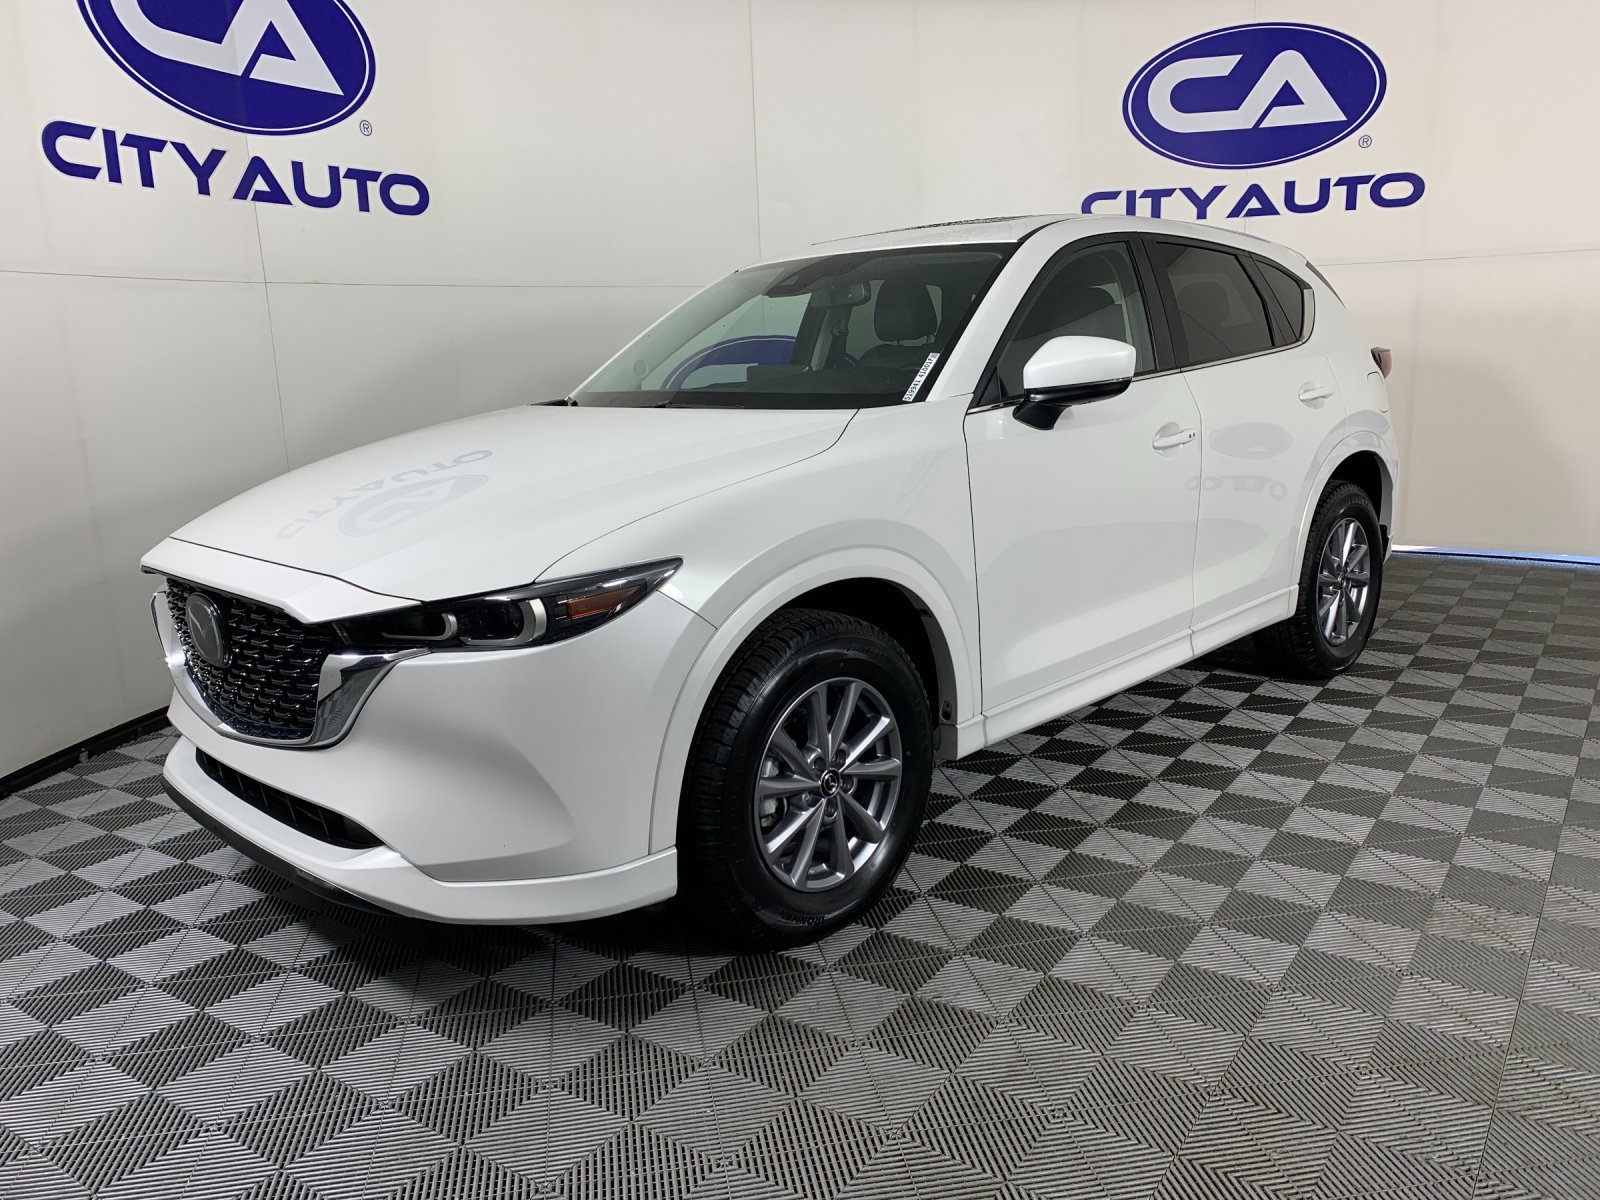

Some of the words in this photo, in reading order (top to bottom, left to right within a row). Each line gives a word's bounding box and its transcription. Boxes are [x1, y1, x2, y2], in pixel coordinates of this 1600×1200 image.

[1148, 49, 1348, 133] CA
[41, 120, 227, 196] CITY
[232, 156, 430, 216] AUTO
[1226, 172, 1425, 219] AUTO
